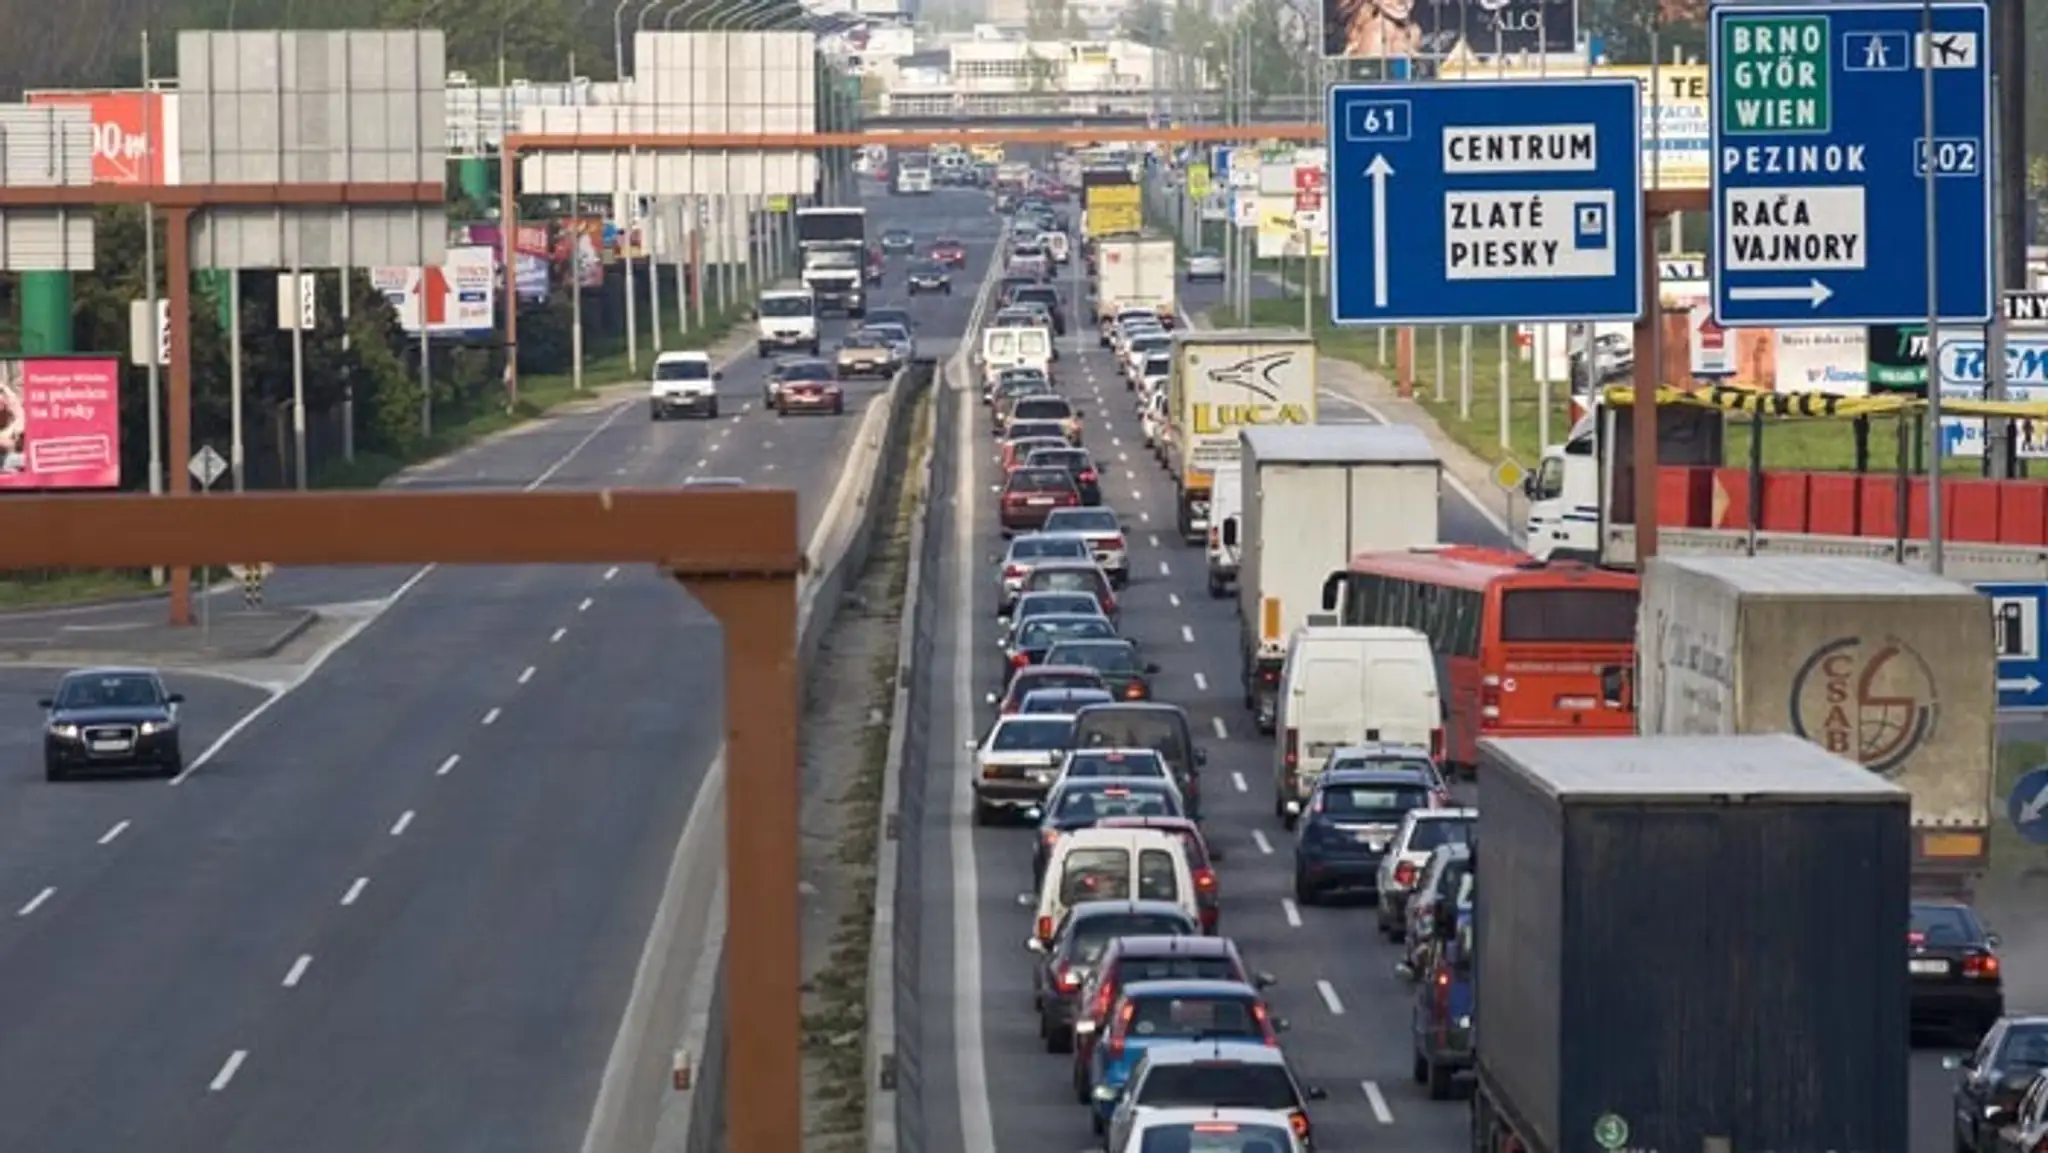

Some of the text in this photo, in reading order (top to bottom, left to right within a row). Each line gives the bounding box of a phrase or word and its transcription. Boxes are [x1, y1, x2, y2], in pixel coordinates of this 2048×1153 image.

[1734, 25, 1820, 54] BRNO
[1734, 55, 1817, 88] GYŐR
[1670, 76, 1709, 98] TE
[1364, 108, 1394, 133] 61
[1735, 98, 1816, 127] WIEN
[1449, 133, 1592, 161] CENTRUM
[1723, 143, 1866, 174] PEZINOK
[1450, 194, 1543, 229] ZLATÉ
[1732, 193, 1811, 227] RAČA
[1451, 240, 1558, 267] PIESKY
[1732, 233, 1858, 261] VAJNORY
[1193, 403, 1309, 434] LUCA
